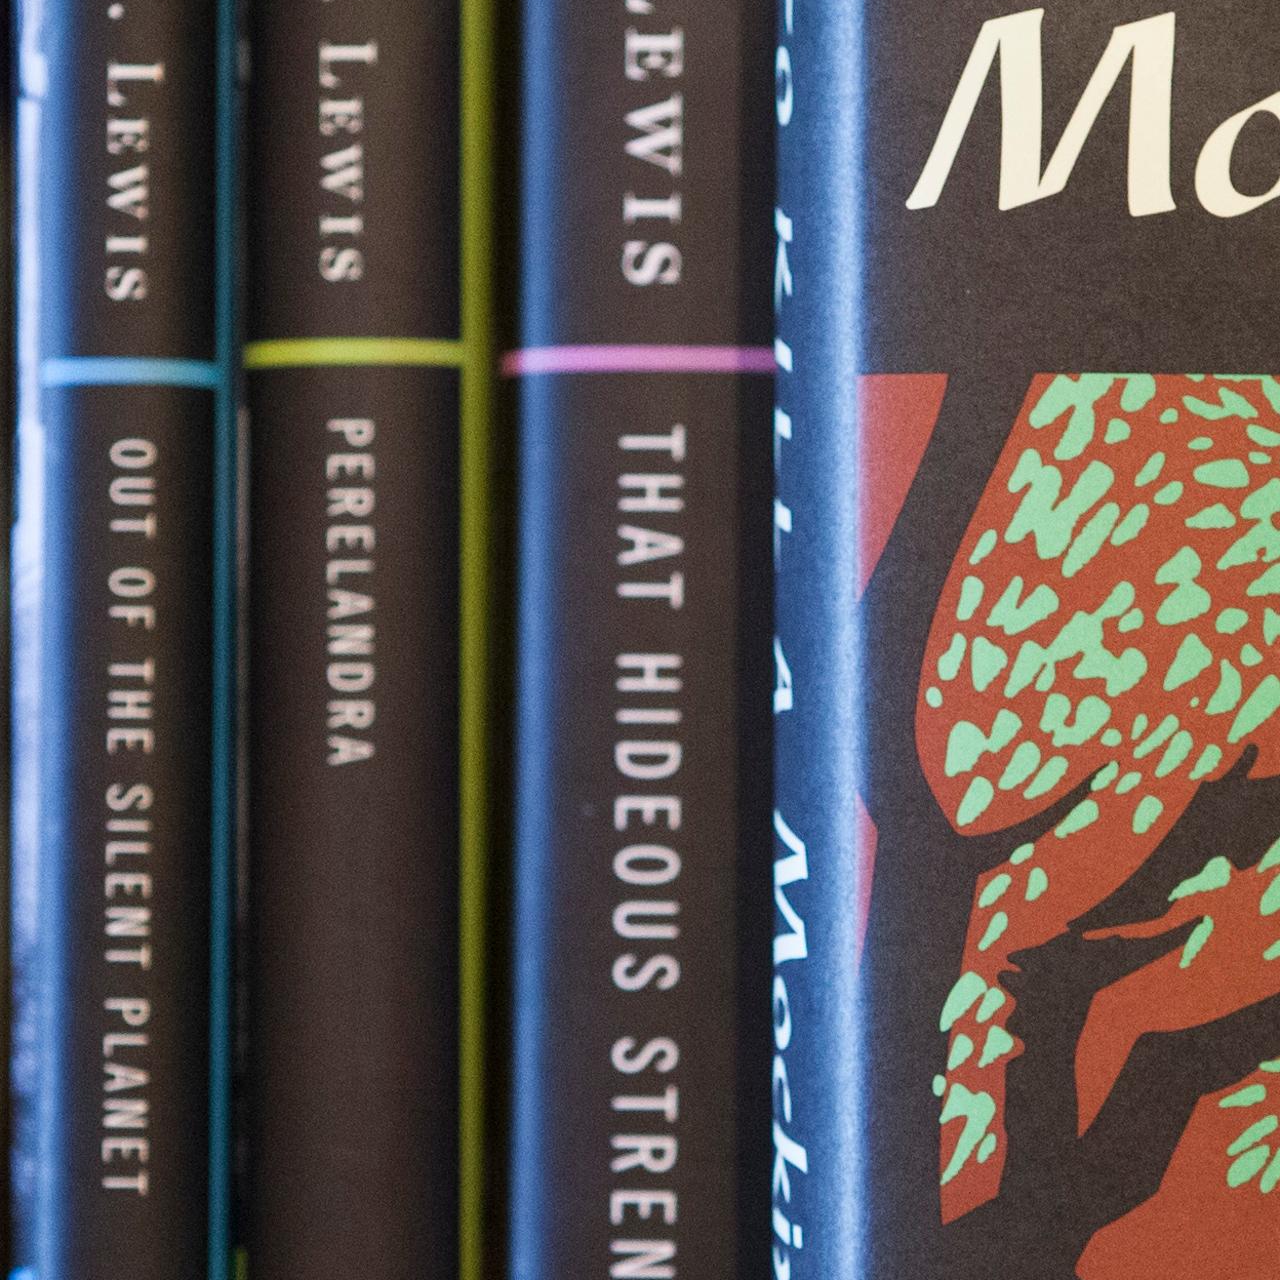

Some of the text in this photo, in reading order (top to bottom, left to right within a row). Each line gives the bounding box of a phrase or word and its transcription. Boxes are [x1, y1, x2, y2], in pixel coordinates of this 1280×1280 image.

[105, 61, 165, 302] LEWIS
[318, 41, 378, 283] LEWIS
[326, 418, 376, 766] PERELANDRA
[617, 424, 686, 609] THAT
[102, 438, 158, 1196] OUT OF THE SILENT PLANET
[612, 653, 683, 992] HIDEOUS
